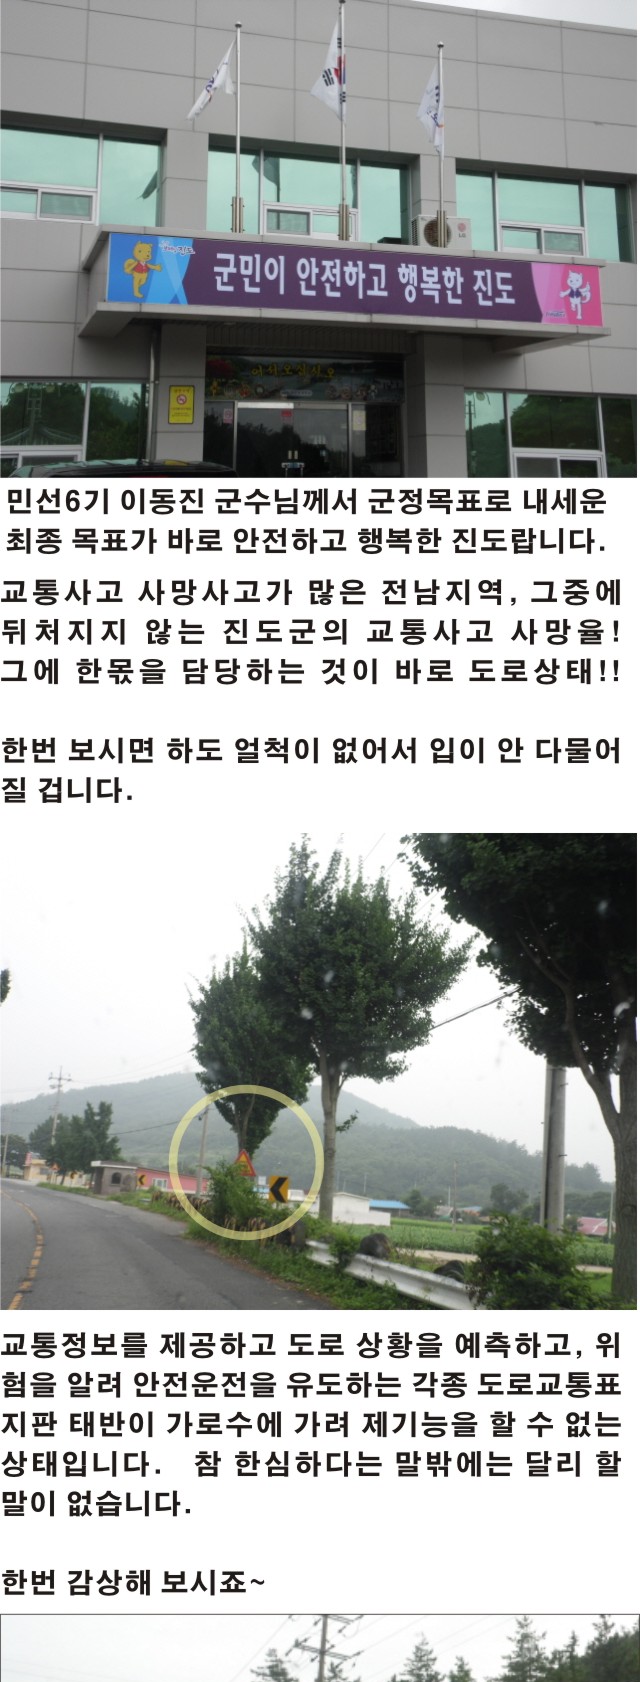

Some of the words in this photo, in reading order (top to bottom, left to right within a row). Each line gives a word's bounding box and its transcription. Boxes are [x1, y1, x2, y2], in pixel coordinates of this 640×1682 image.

[213, 253, 285, 295] 군민이
[296, 257, 389, 300] 안전하고
[397, 262, 465, 305] 행복한
[473, 268, 516, 306] 진도
